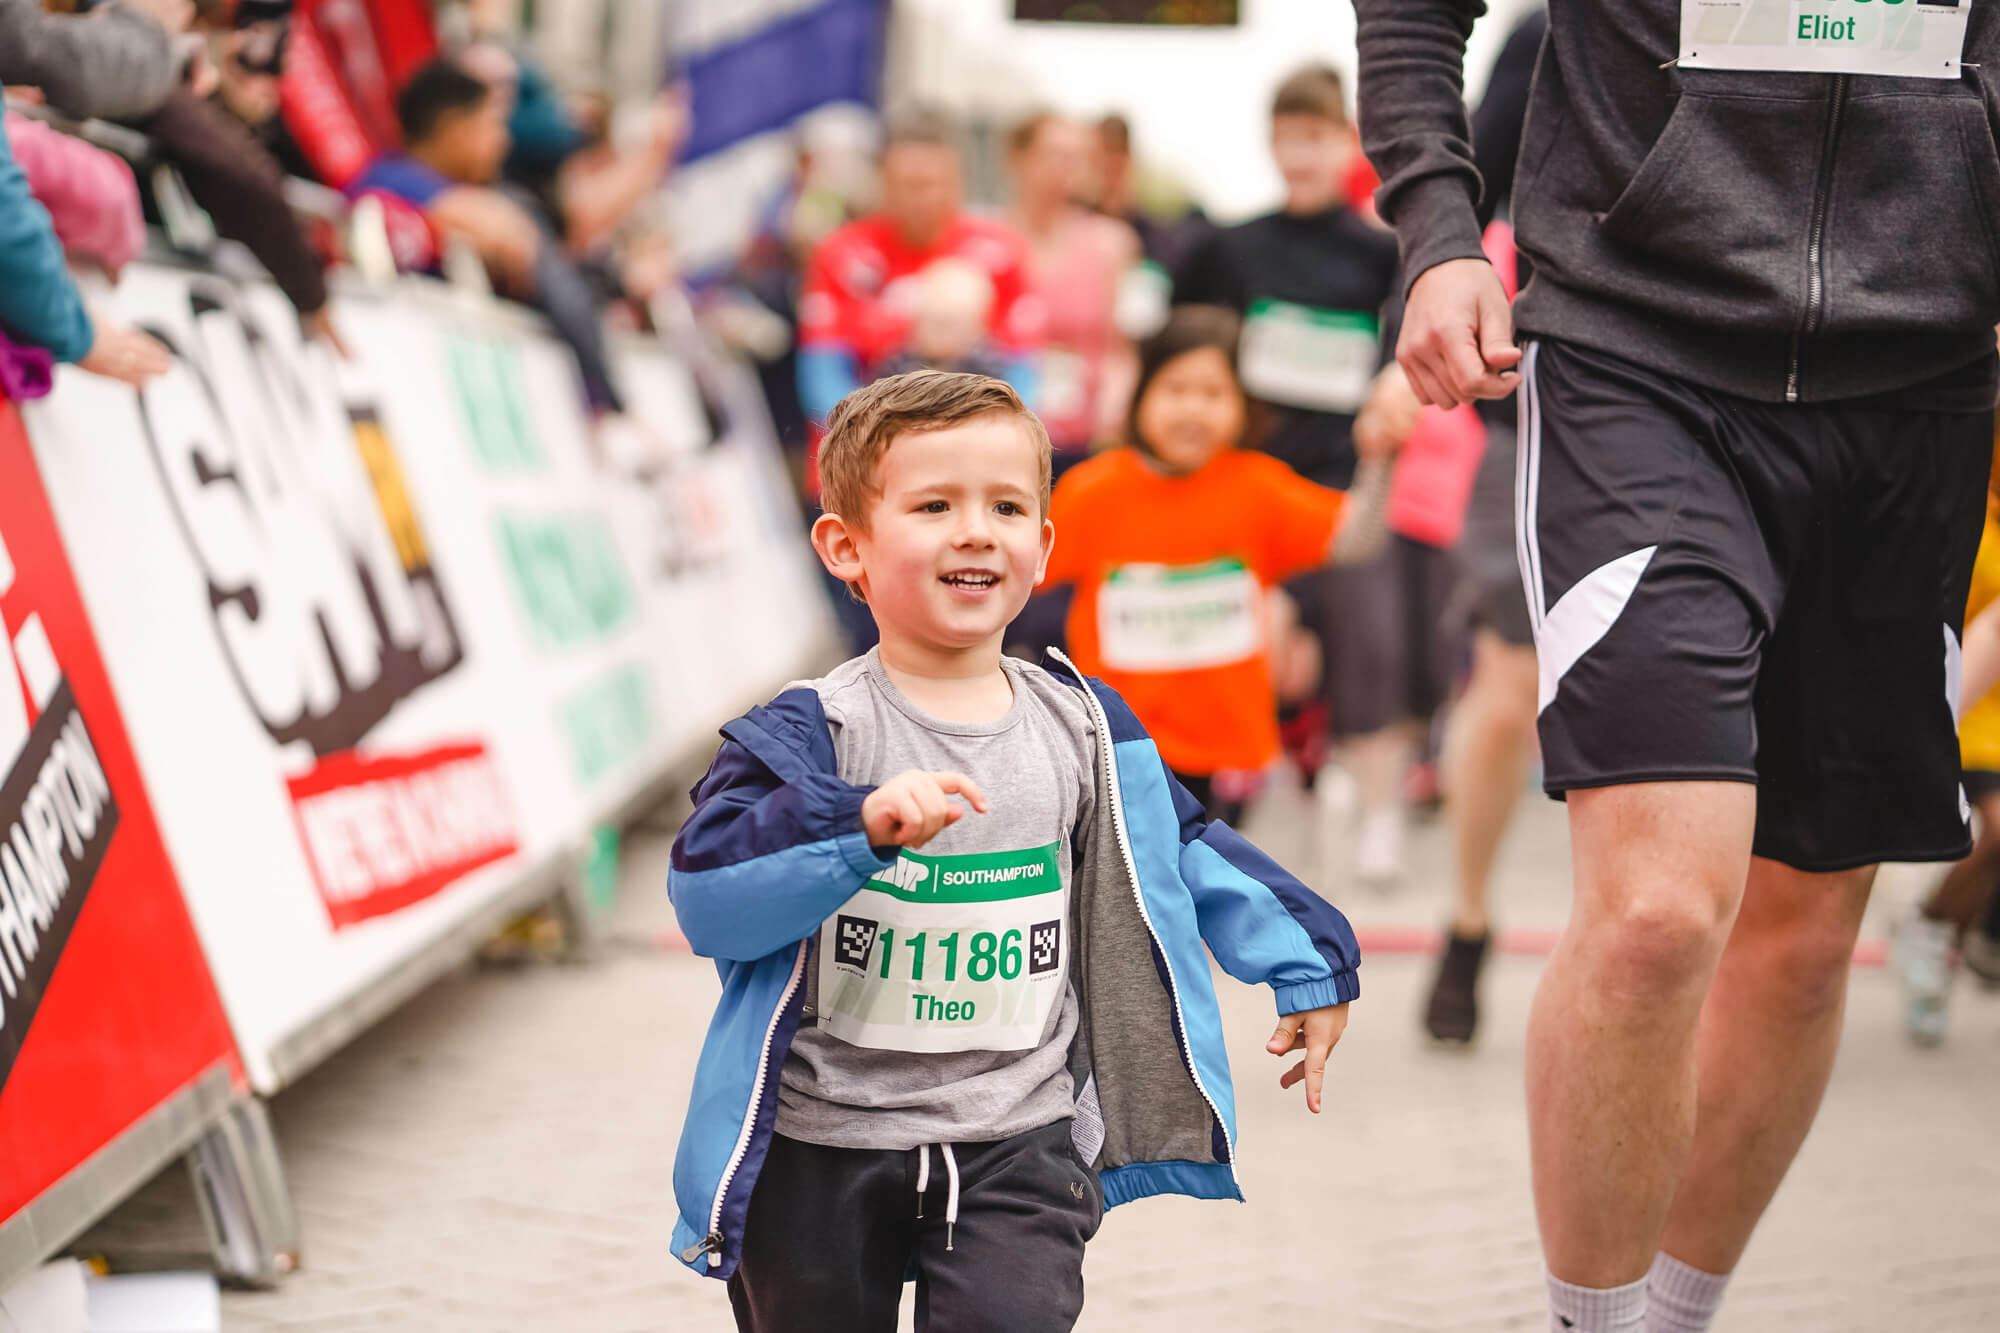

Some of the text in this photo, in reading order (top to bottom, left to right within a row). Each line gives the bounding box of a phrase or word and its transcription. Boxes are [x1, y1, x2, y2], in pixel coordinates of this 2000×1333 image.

[1797, 14, 1856, 41] Eliot
[0, 708, 111, 1031] HAMPTON
[942, 862, 1045, 886] SOUTHAMPTON
[879, 926, 1023, 983] 11186
[911, 993, 976, 1022] Theo
